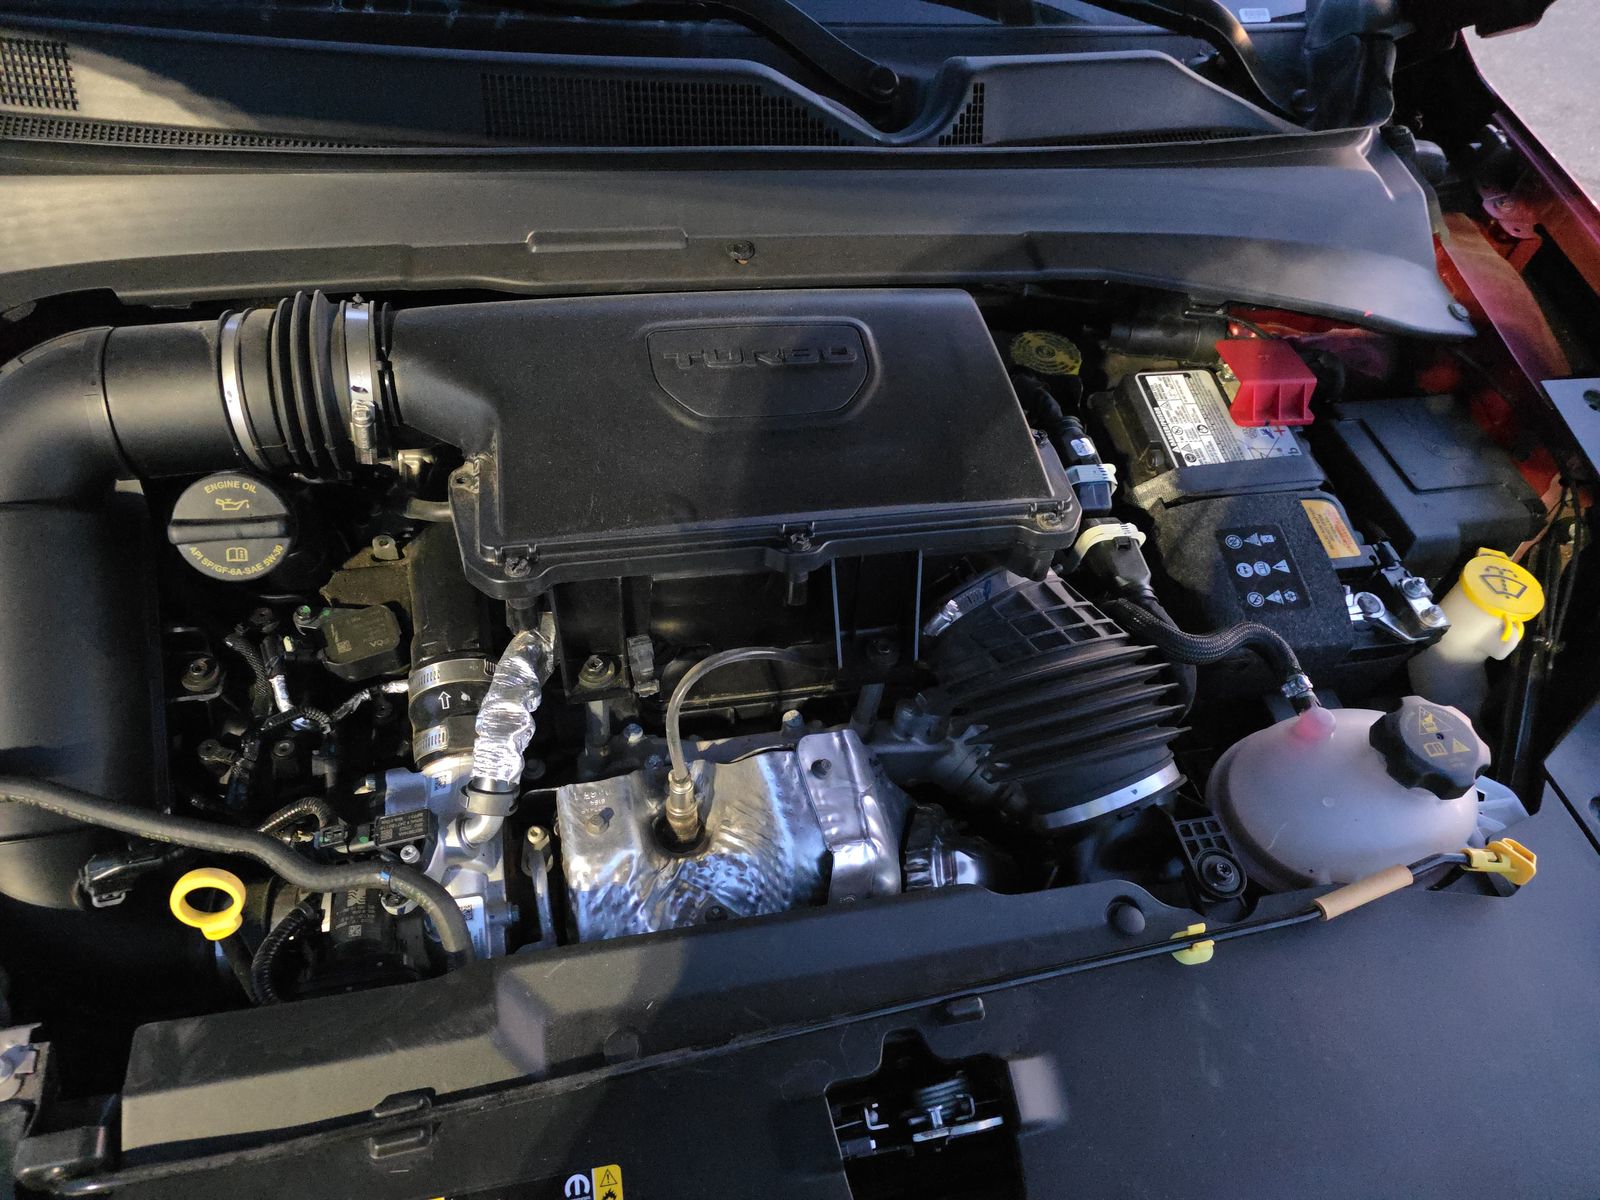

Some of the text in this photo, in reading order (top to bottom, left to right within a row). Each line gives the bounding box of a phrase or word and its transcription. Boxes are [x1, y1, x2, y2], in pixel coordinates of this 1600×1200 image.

[663, 346, 858, 370] TURBO
[204, 480, 257, 494] ENGINE OIL
[190, 546, 203, 560] API
[263, 543, 284, 567] 5W-30
